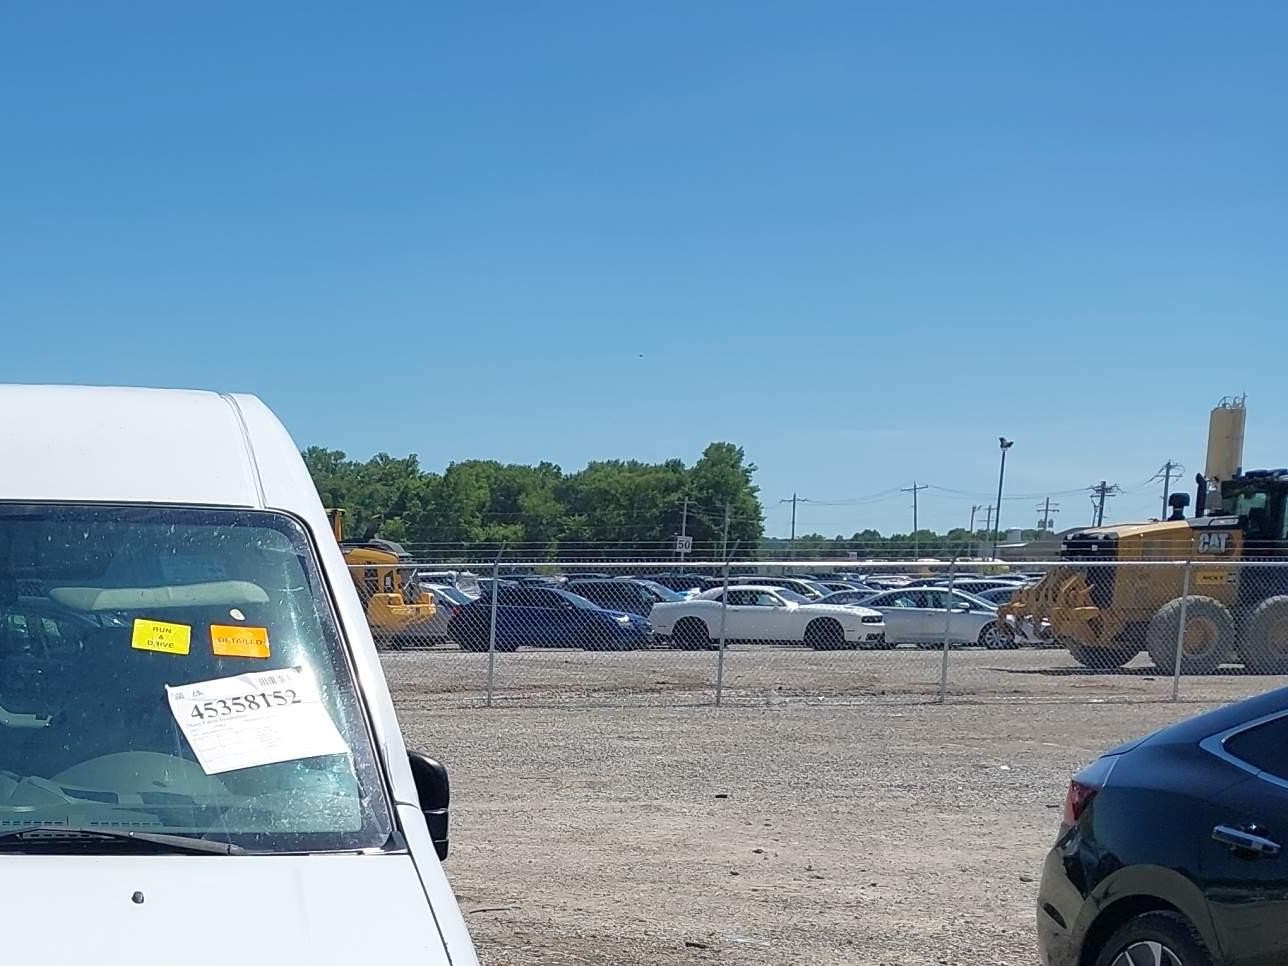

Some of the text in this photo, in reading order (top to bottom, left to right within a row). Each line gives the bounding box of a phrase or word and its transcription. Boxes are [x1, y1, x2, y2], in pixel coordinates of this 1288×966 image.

[678, 541, 690, 549] 50
[1198, 533, 1228, 553] CAT
[152, 626, 172, 634] RUN
[191, 689, 301, 719] 45358152
